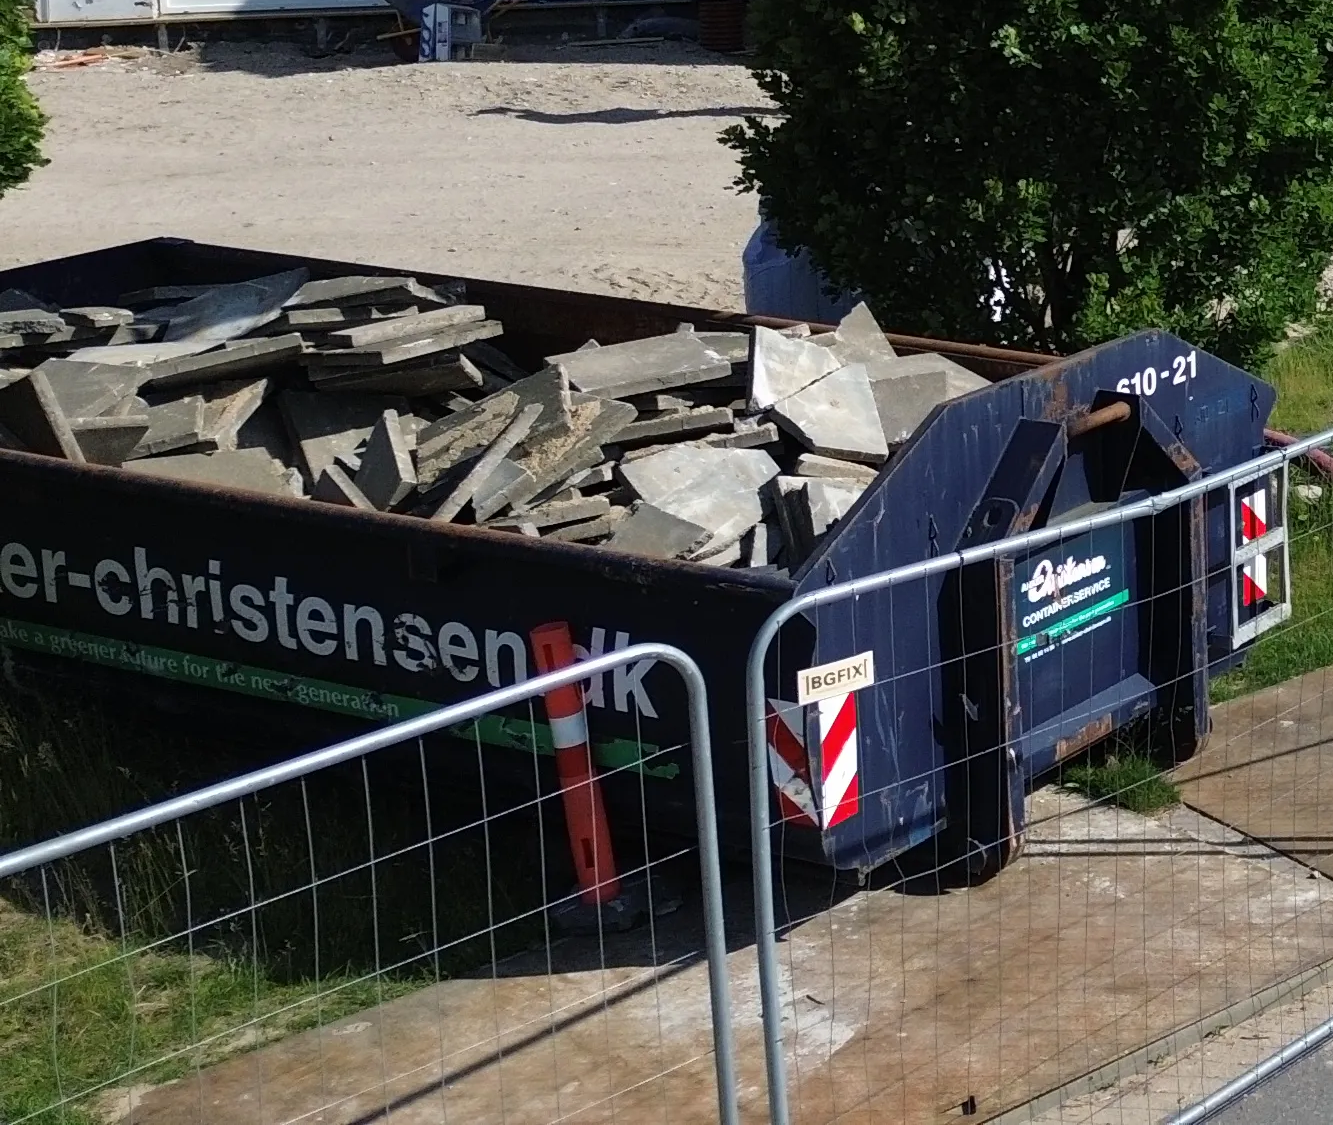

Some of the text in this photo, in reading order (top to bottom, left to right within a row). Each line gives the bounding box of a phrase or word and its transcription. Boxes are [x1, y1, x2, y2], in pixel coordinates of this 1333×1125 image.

[0, 541, 659, 719] er-christensendk
[182, 655, 209, 679] for
[810, 662, 864, 691] BGFIX
